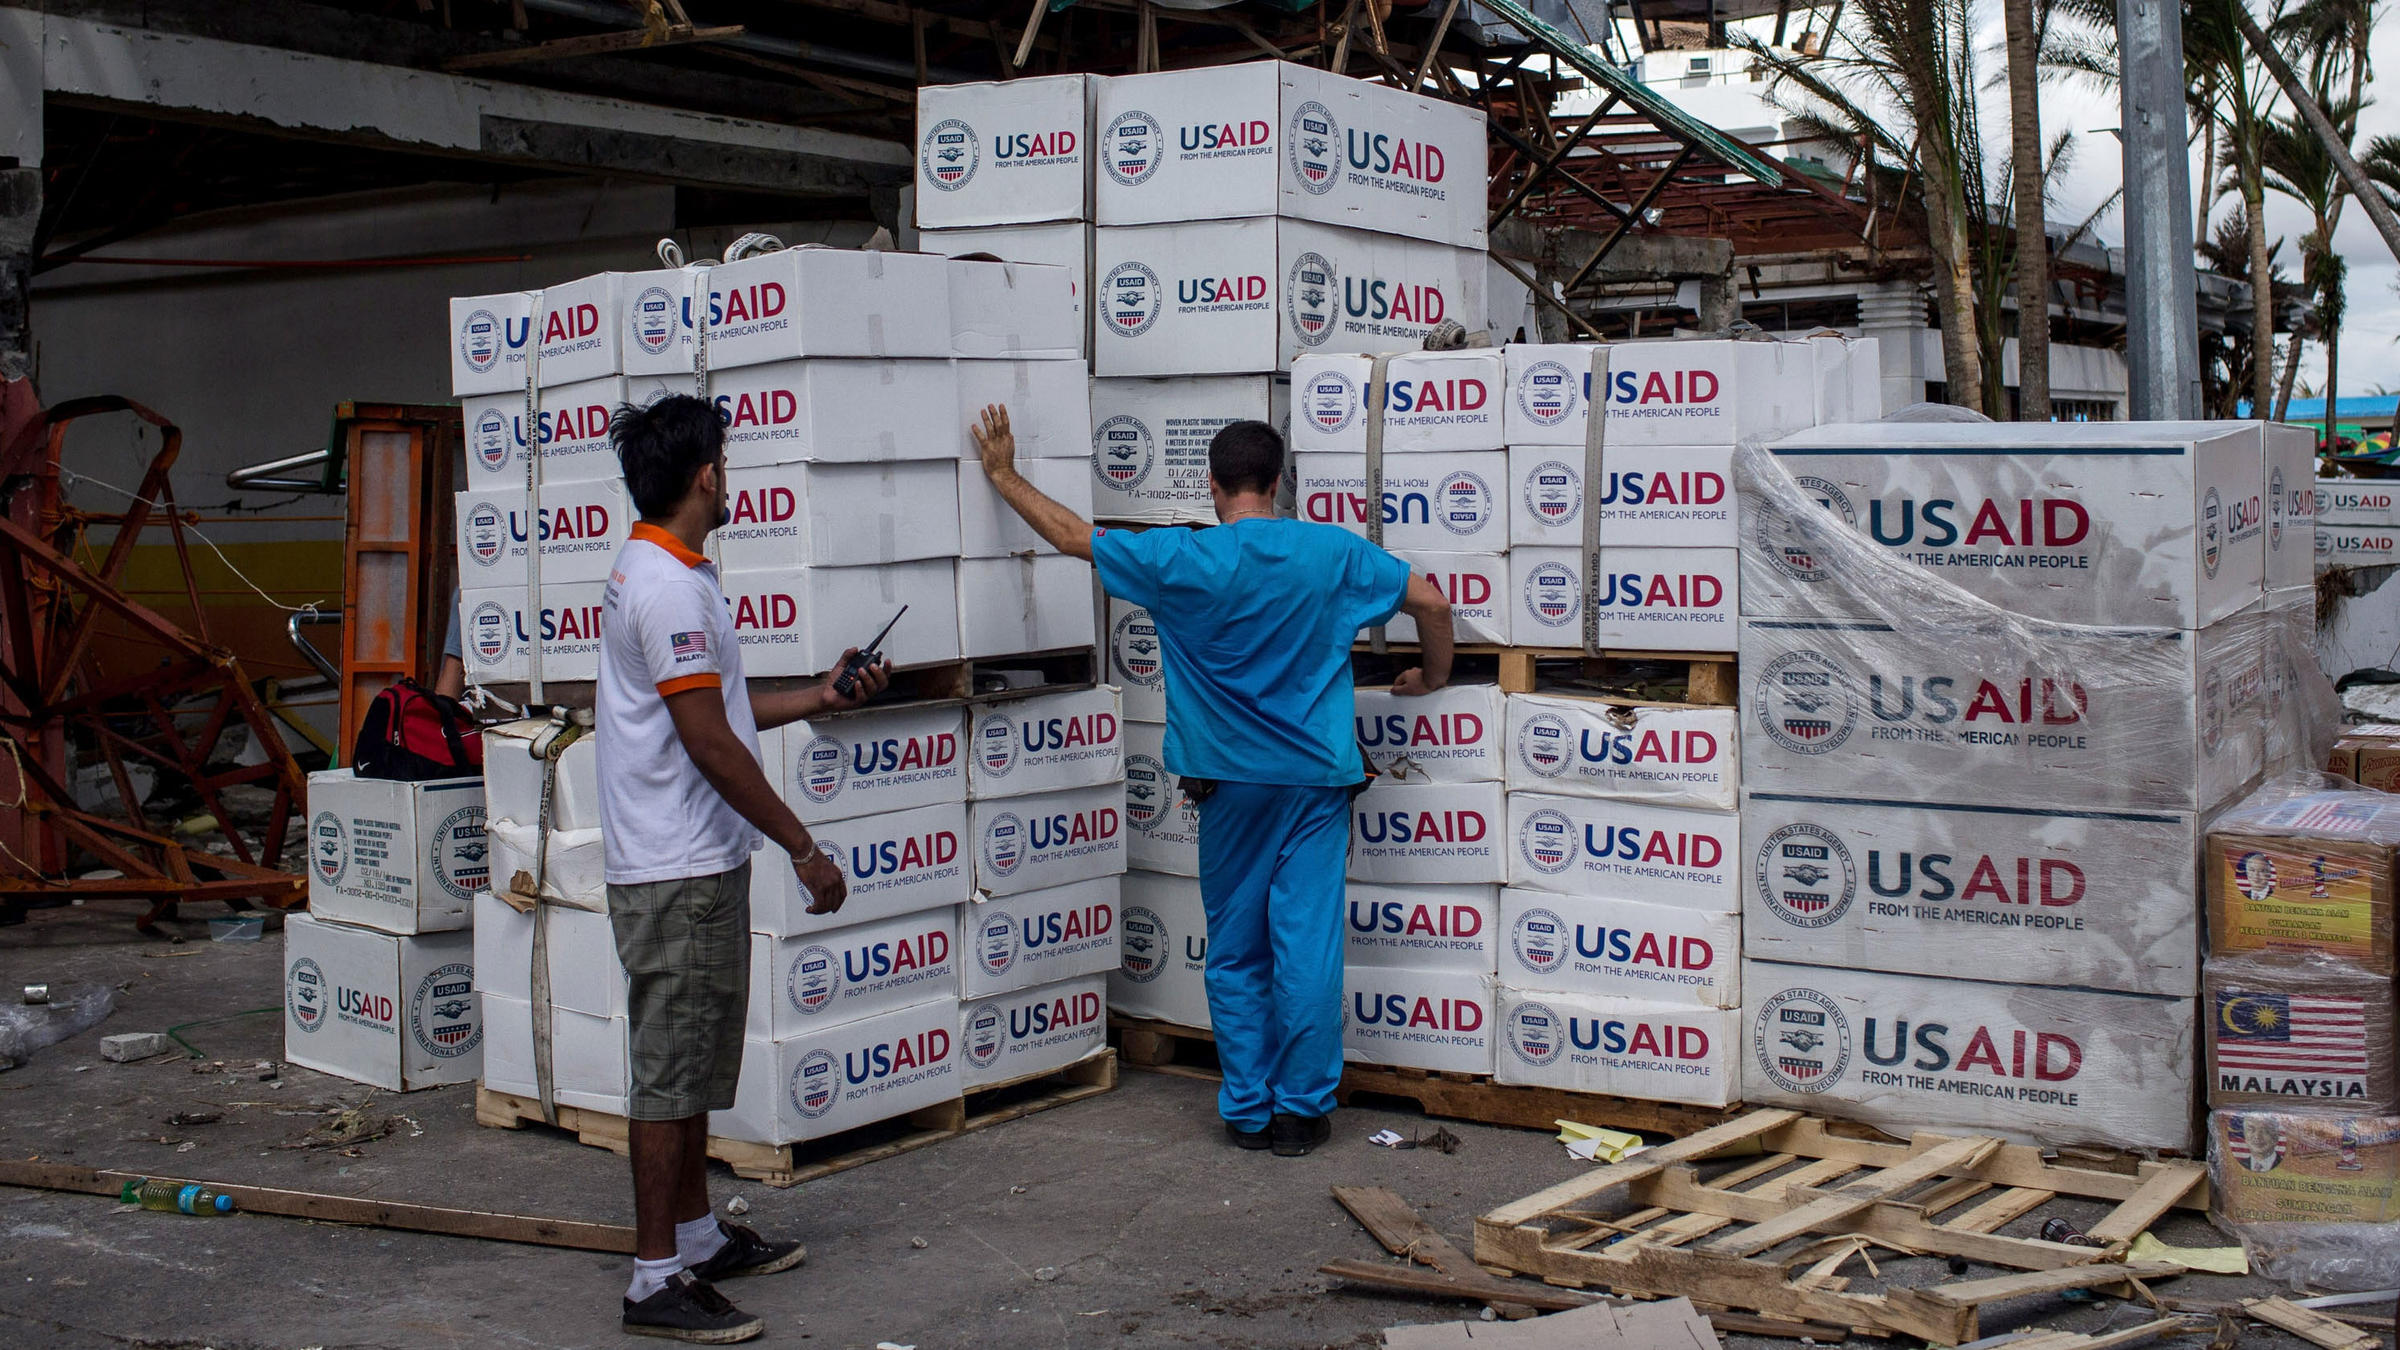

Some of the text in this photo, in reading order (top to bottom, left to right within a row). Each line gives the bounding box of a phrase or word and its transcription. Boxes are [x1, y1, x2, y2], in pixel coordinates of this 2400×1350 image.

[995, 131, 1076, 158] USAID
[1121, 126, 1146, 136] USAID
[1180, 120, 1269, 151] USAID
[1180, 146, 1272, 160] FROM THE AMERICAN PEOPLE
[1348, 128, 1445, 184] USAID
[1348, 174, 1444, 201] FROM THE AMERICAN PEOPLE
[1120, 278, 1143, 286] USAID
[1178, 275, 1267, 304] USAID
[1345, 276, 1445, 325] USAID
[506, 302, 599, 348] UAID
[720, 319, 788, 340] AMERICAN PEOPLE
[1319, 386, 1340, 394] USAID
[1536, 376, 1559, 384] USAID
[711, 389, 797, 428] SAID
[1111, 432, 1134, 440] USAID
[1188, 448, 1207, 456] CANVAS
[726, 488, 796, 524] AID
[1618, 511, 1726, 519] THE AMERICAN PEOPLE
[2228, 496, 2260, 533] USAID
[2288, 490, 2313, 516] USAID
[2336, 495, 2391, 507] USAID
[1870, 498, 2090, 547] USAID
[548, 542, 610, 554] AMERICAN PEOPLE
[2338, 537, 2392, 549] USAID
[735, 594, 796, 629] AID
[1132, 626, 1156, 634] USAID
[1869, 674, 2089, 724] USAID
[1023, 713, 1116, 752] USAID
[1356, 713, 1483, 747] USAID
[1536, 728, 1557, 736] USAID
[1580, 728, 1717, 765] USAID
[853, 733, 956, 775] USAID
[1024, 748, 1118, 766] FROM THE AMERICAN PEOPLE
[853, 768, 955, 791] FROM THE AMERICAN PEOPLE
[1130, 771, 1153, 780] USAID
[1579, 767, 1717, 782] FROM THE AMERICAN PEOPLE
[1030, 808, 1118, 850] USAID
[1359, 810, 1486, 843] USAID
[1538, 824, 1561, 832] USAID
[852, 831, 957, 878] USAID
[1362, 847, 1488, 857] FROM THE AMERICAN PEOPLE
[1585, 824, 1722, 868] USAID
[1762, 826, 1850, 862] UNITED STATES AGENCY
[1788, 846, 1822, 858] USAID
[1584, 861, 1721, 884] FROM THE AMERICAN PEOPLE
[1867, 850, 2086, 907] USAID
[1758, 872, 1854, 926] INTERNATIONAL DEVELOPMENT
[1023, 904, 1112, 947] USAID
[1350, 901, 1482, 937] USAID
[1869, 902, 2083, 930] FROM THE AMERICAN PEOPLE
[844, 931, 949, 982] USAID
[1576, 924, 1713, 970] USAID
[438, 984, 466, 996] USAID
[1575, 962, 1712, 986] FROM THE AMERICAN PEOPLE
[338, 986, 392, 1022] USAID
[1010, 992, 1099, 1039] USAID
[1355, 992, 1483, 1032] USAID
[1760, 990, 1846, 1029] UNITED STATES AGENCY
[1784, 1011, 1818, 1023] USAID
[1570, 1017, 1709, 1060] USAID
[1864, 1018, 2082, 1081] USAID
[846, 1028, 950, 1084] USAID
[1756, 1036, 1848, 1092] INTERNATIONAL DEVELOPMENT
[847, 1065, 951, 1101] FROM THE AMERICAN PEOPLE
[1863, 1071, 2077, 1106] FROM THE AMERICAN PEOPLE
[2222, 1075, 2366, 1097] MALAYSIA
